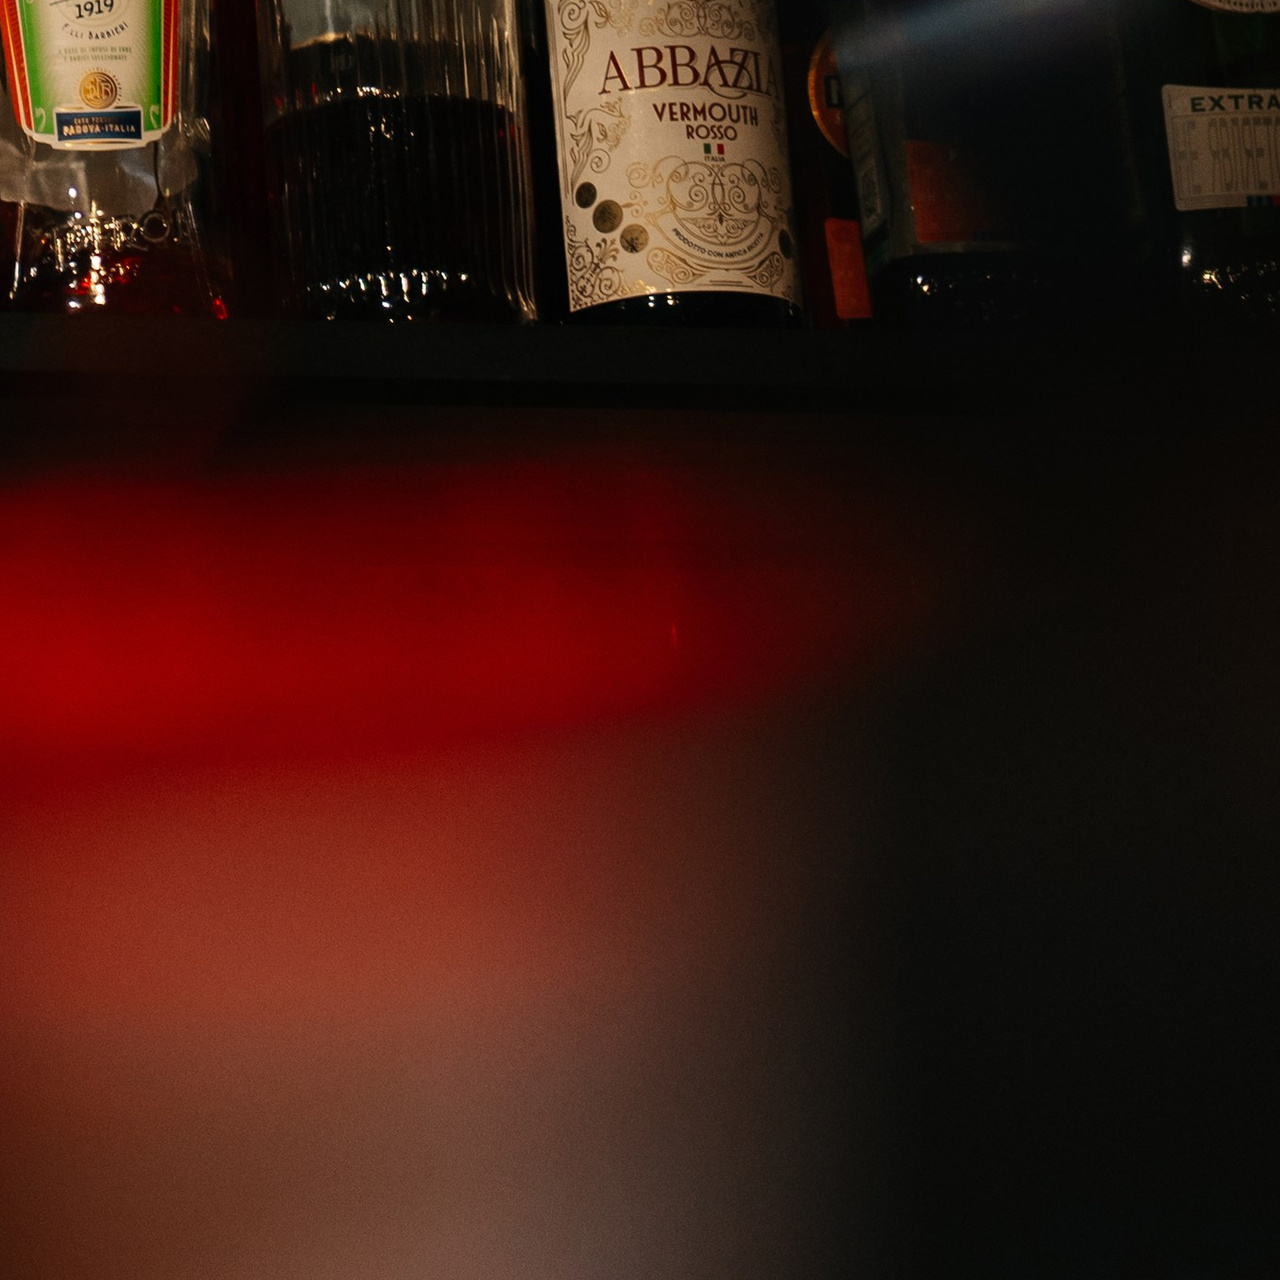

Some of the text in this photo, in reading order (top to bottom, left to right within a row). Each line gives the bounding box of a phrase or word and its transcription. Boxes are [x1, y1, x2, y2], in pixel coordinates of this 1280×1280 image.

[87, 20, 130, 41] BARBIERI
[598, 44, 781, 101] ABBAZIA
[652, 102, 759, 127] VERMOUTH
[1189, 94, 1280, 113] EXTRA
[685, 124, 738, 141] ROSSO
[671, 227, 707, 256] PRODOTTO
